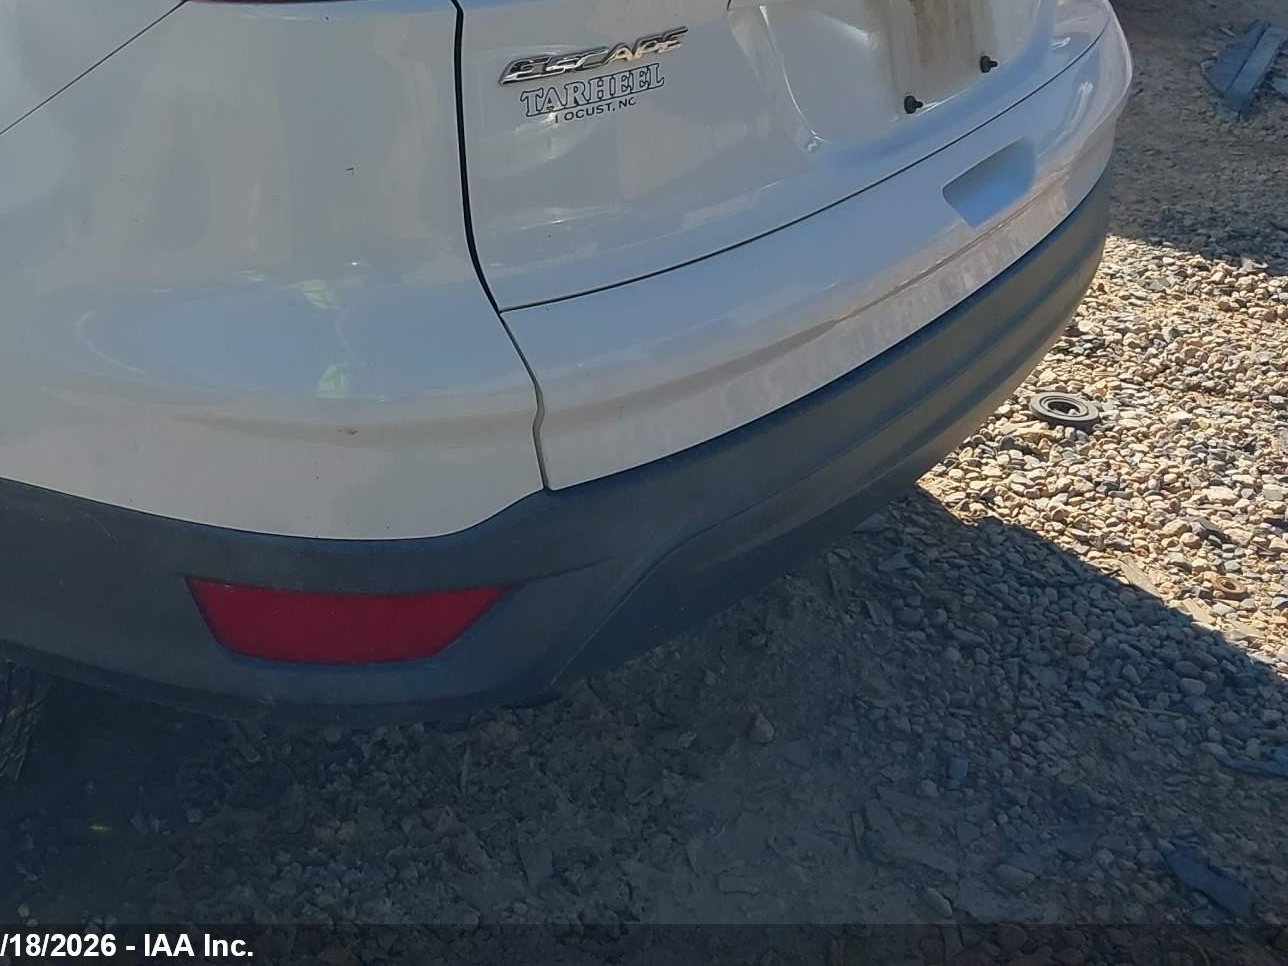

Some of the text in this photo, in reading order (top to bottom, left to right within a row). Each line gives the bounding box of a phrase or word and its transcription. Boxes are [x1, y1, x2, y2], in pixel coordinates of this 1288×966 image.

[499, 26, 688, 85] ESCAPE
[520, 63, 665, 117] TARHEEL
[618, 96, 637, 109] NC
